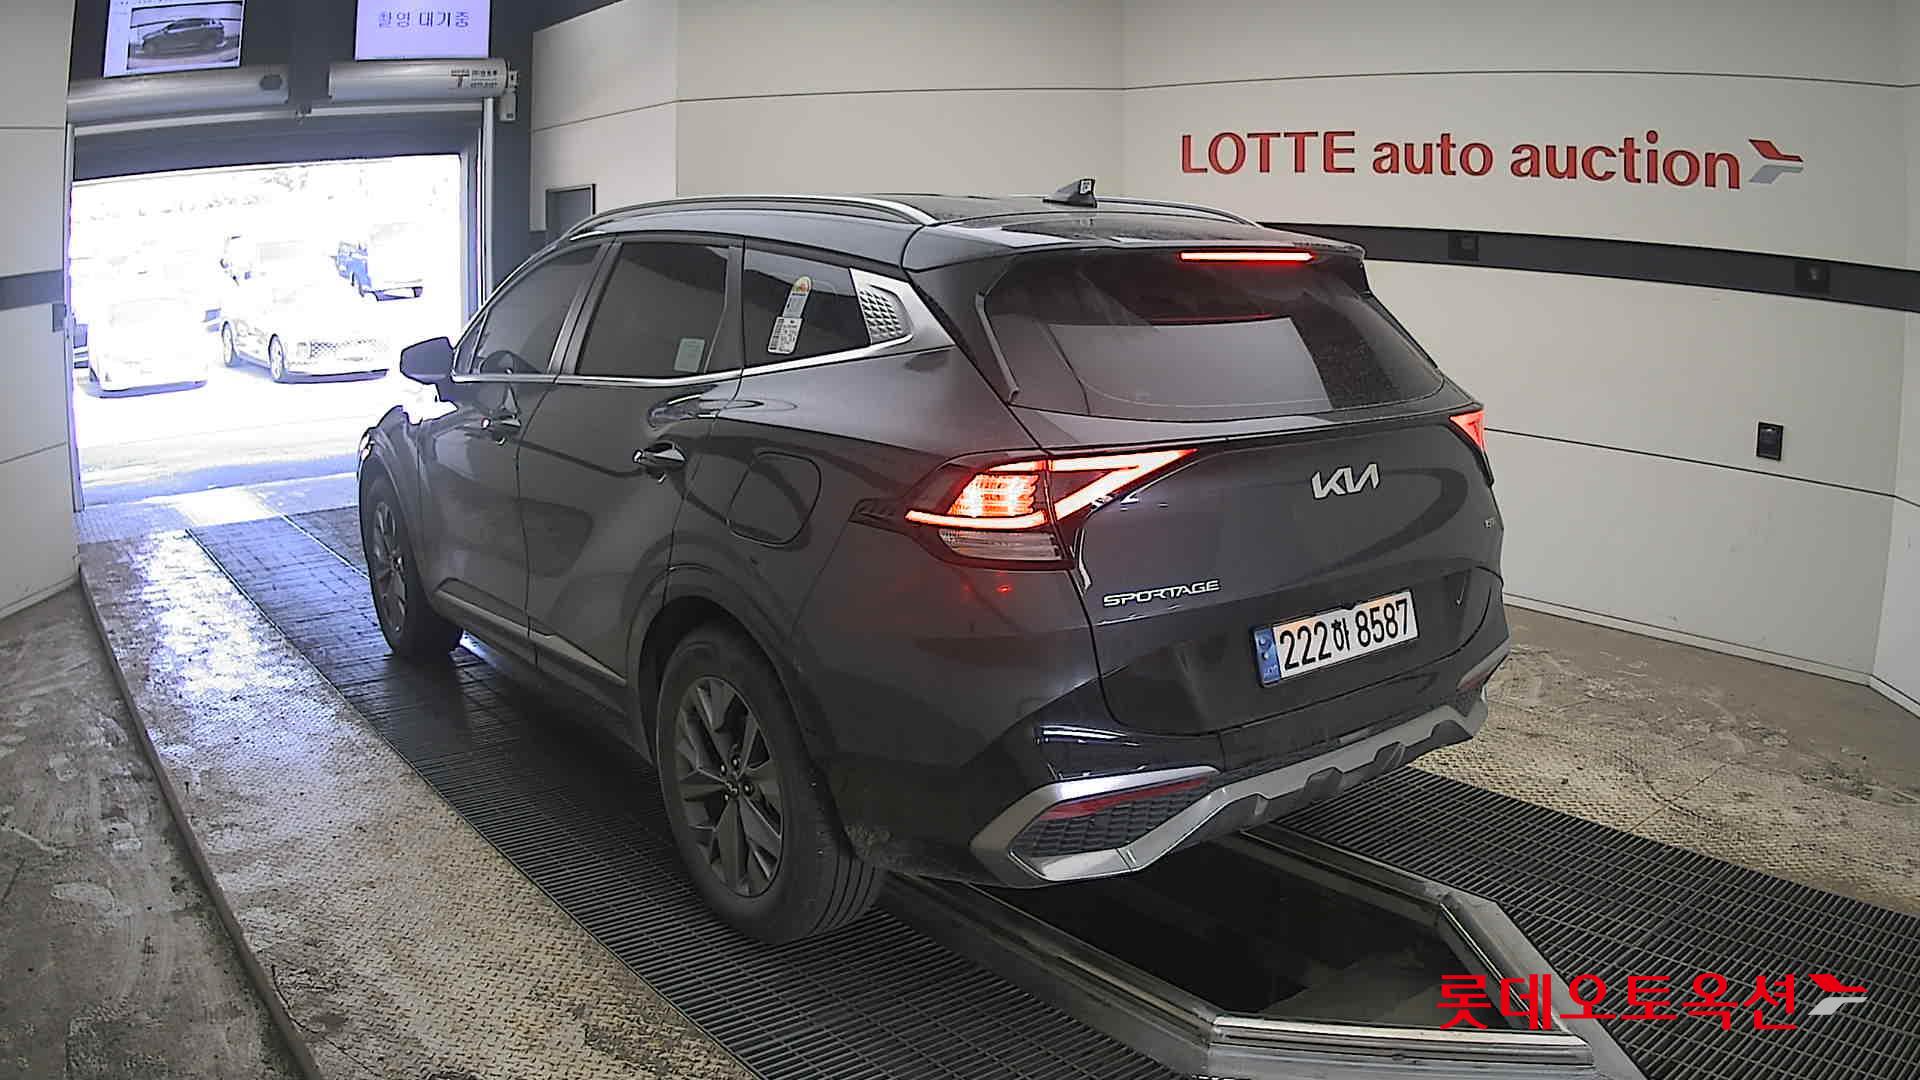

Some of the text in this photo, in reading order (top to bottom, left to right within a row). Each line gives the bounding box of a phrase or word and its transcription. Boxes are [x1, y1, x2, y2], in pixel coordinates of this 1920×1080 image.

[419, 10, 469, 28] 대기중
[1182, 130, 1741, 190] LOTTE auto auction
[1311, 463, 1380, 499] KIA
[1102, 579, 1220, 607] SPORTAGE
[1279, 598, 1408, 670] 222하 8587
